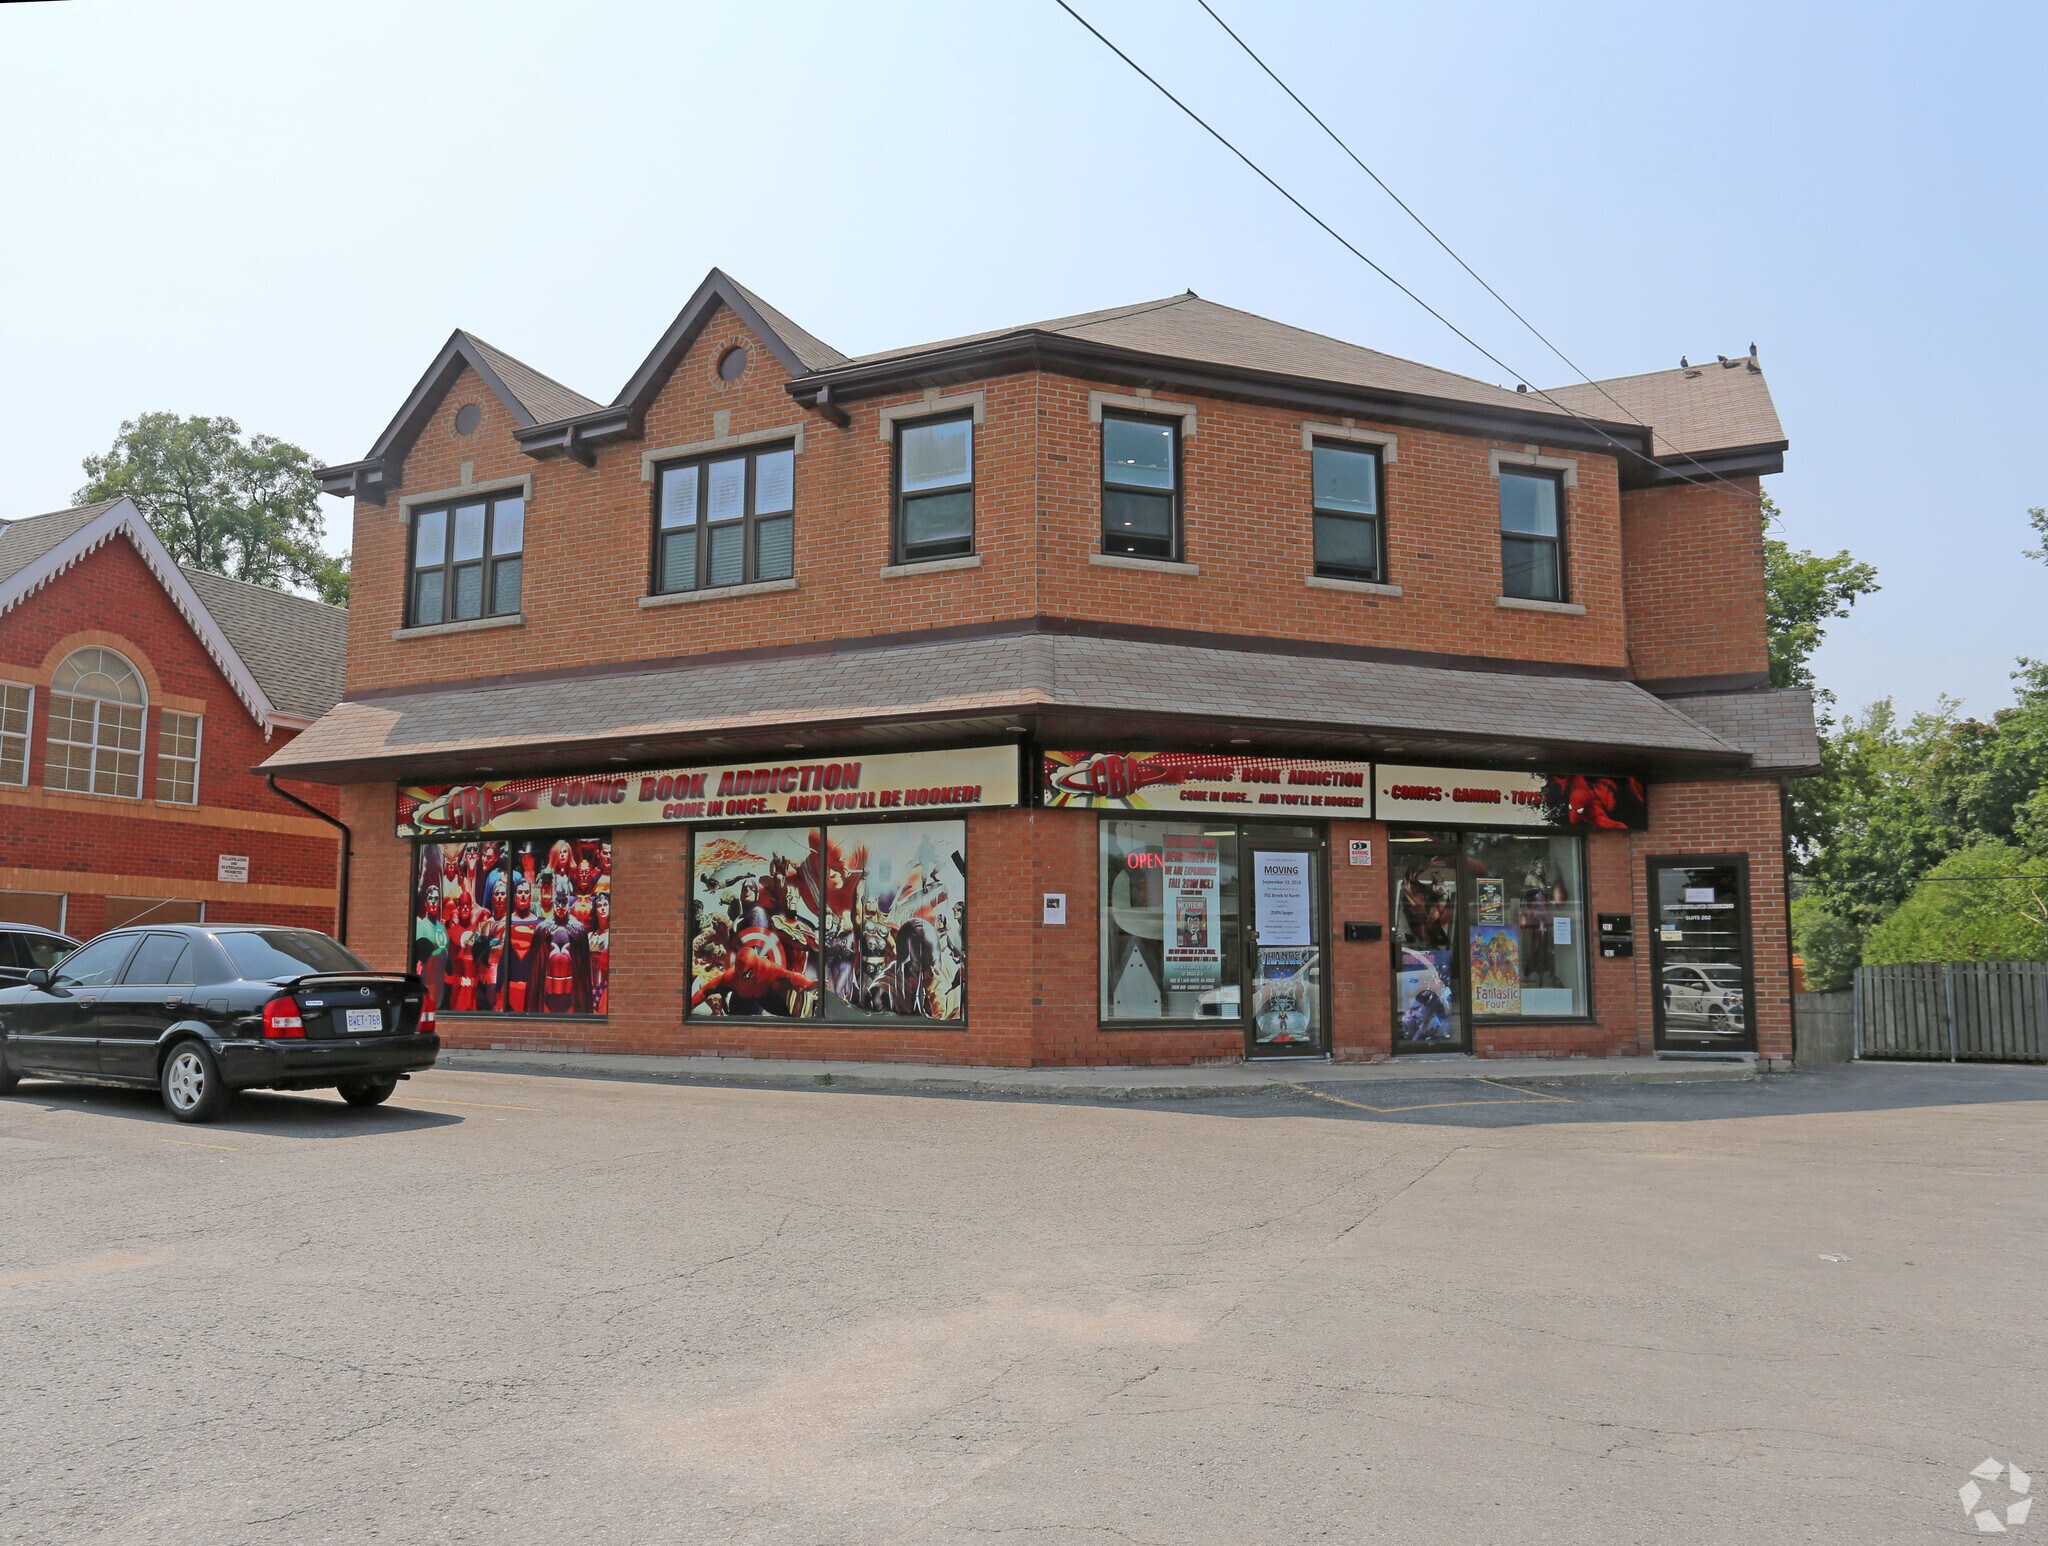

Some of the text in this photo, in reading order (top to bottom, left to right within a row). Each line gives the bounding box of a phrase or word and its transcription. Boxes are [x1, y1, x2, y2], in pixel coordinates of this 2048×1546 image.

[550, 762, 861, 807] COMIC BOOK ADDICTION
[1091, 755, 1139, 798] CBA
[1185, 766, 1364, 787] COMIC BOOK ADDICTION
[662, 784, 983, 819] COME IN ONCE... AND YOU'LL BE HOOKED!
[1179, 790, 1208, 801] COME
[1209, 790, 1220, 802] IN
[1258, 793, 1278, 804] AND
[1280, 794, 1310, 806] YOU'LL
[1311, 795, 1323, 806] BE
[1324, 796, 1365, 808] HOOKED!
[1391, 784, 1541, 805] COMICS GAMING TOYS
[449, 786, 497, 830] CBA
[1127, 852, 1164, 869] OPEN
[1264, 866, 1299, 874] MOVING
[1178, 901, 1204, 910] WOLVERINE
[1262, 951, 1302, 965] THANOS
[1476, 986, 1518, 1000] Fantastic
[348, 1014, 380, 1026] BWET 768
